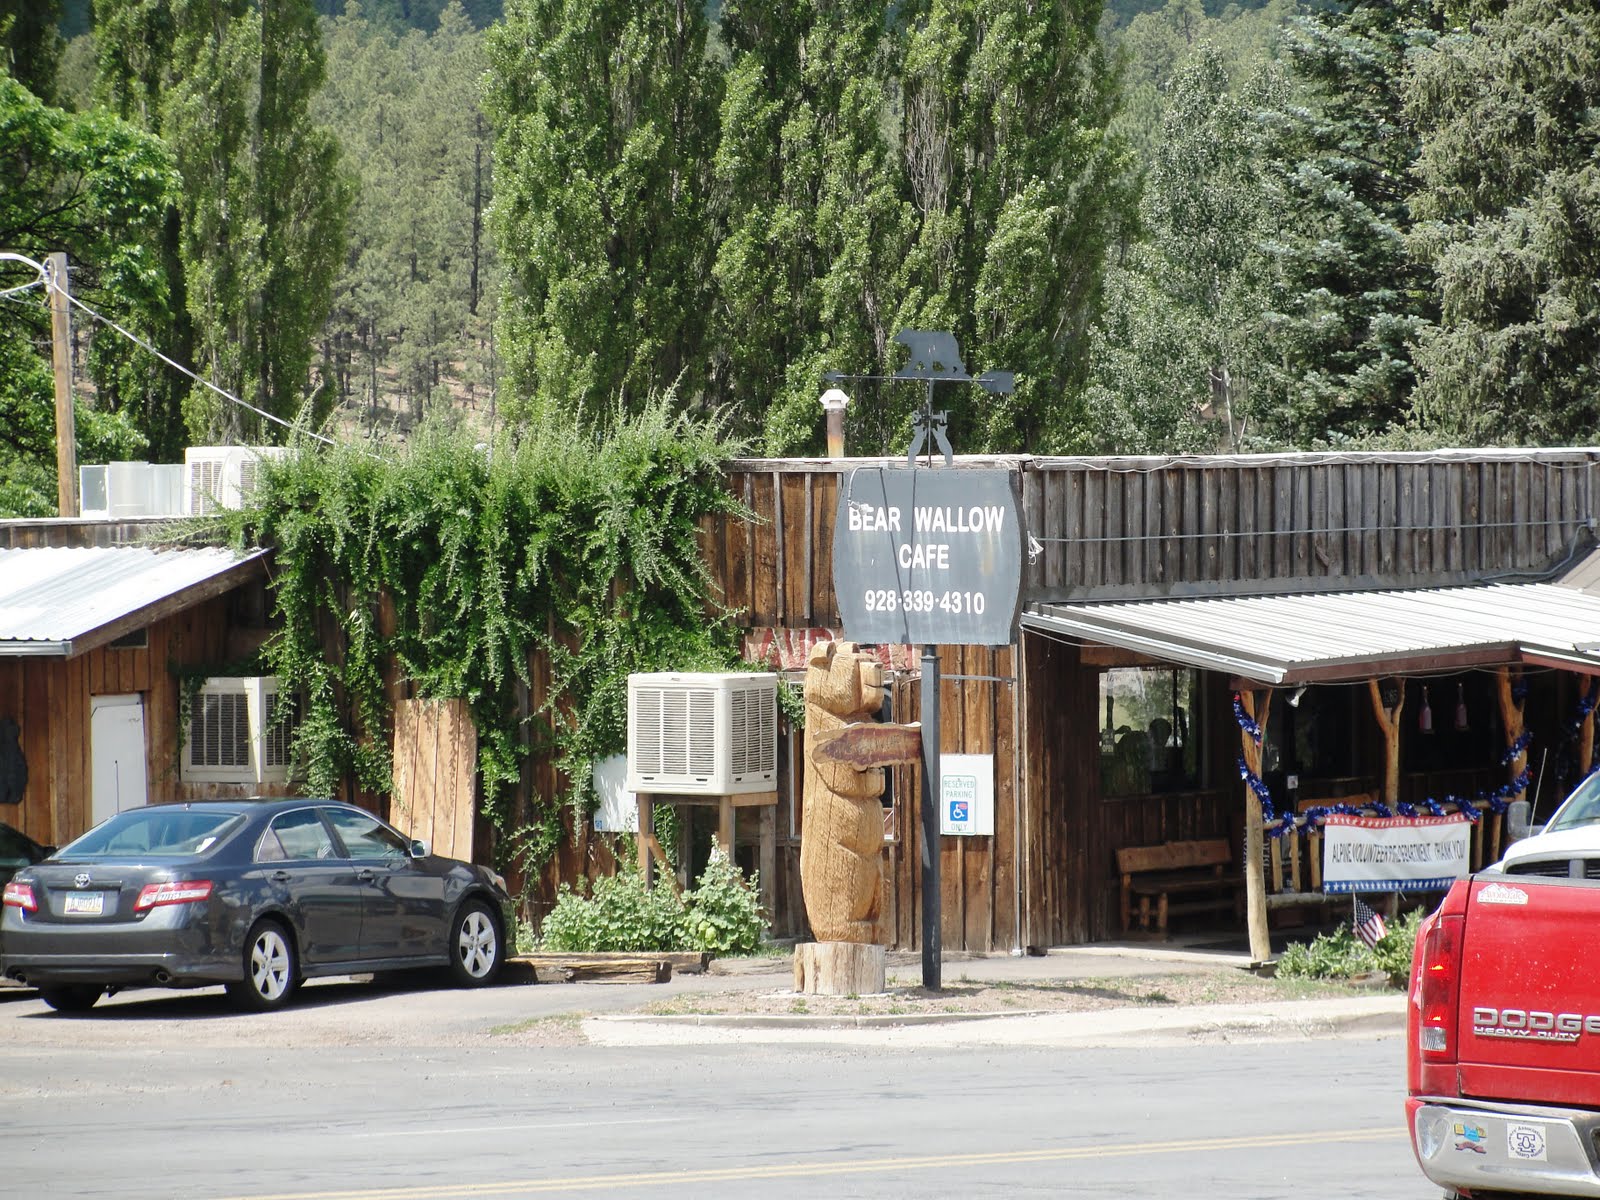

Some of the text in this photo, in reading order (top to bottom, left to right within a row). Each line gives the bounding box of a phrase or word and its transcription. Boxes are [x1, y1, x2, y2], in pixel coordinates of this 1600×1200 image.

[849, 505, 1005, 532] BEAR WALLOW
[899, 544, 950, 569] CAFE
[943, 780, 975, 789] RESERVED
[945, 790, 973, 798] PARKING
[1332, 842, 1352, 863] ALPINE
[1474, 1026, 1581, 1040] HEAVY DUTY
